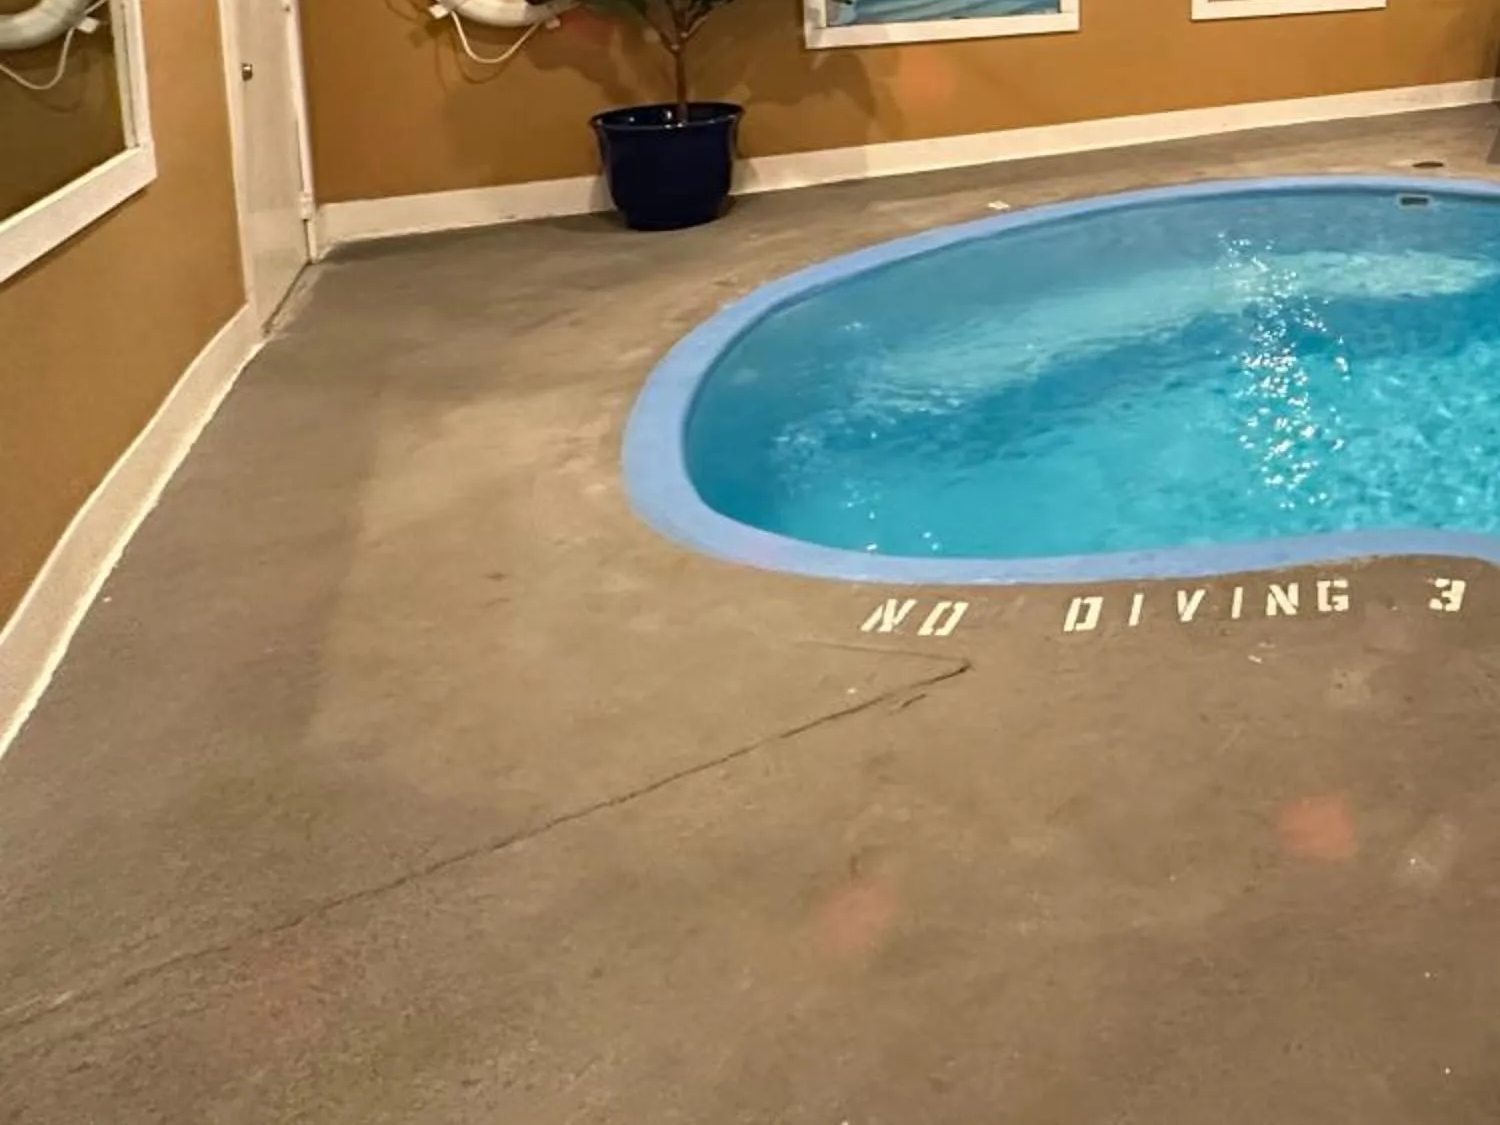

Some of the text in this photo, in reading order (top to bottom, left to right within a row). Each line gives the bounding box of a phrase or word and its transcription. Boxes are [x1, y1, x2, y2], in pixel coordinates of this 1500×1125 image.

[861, 578, 1467, 636] NO DIVING 3
